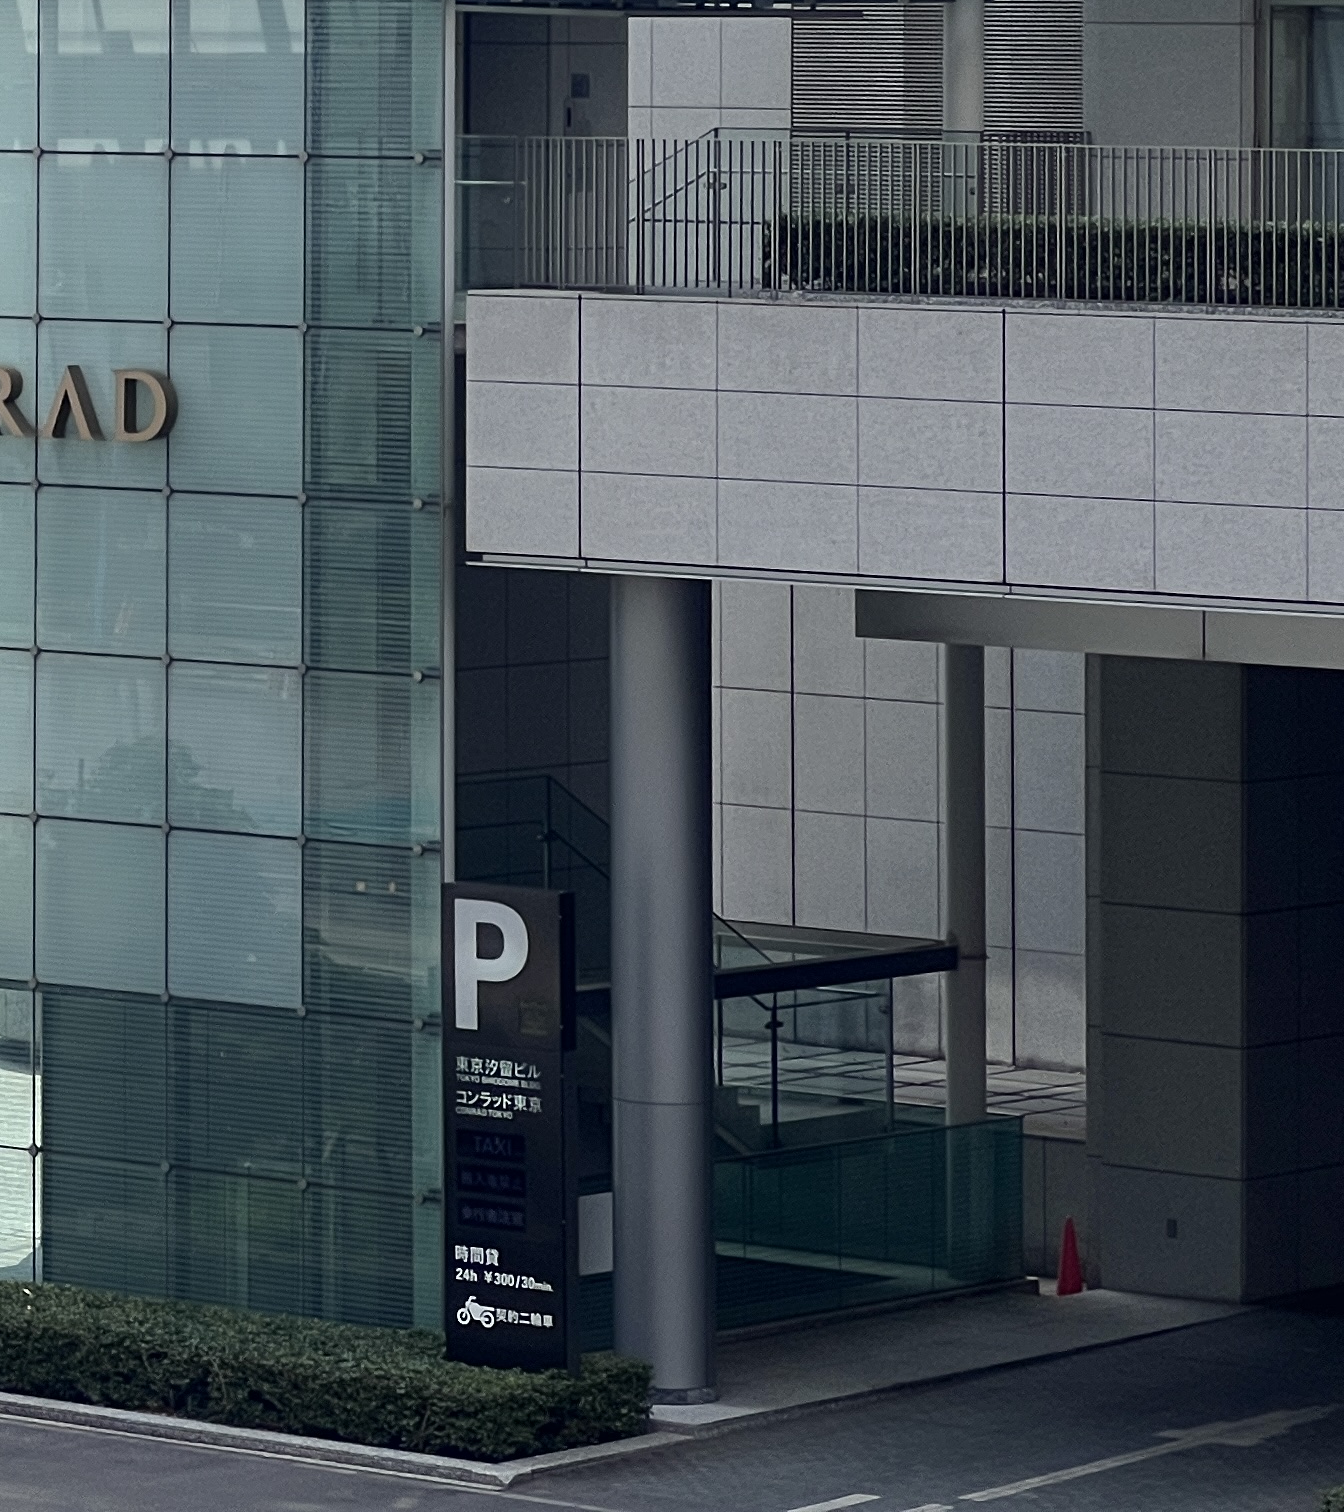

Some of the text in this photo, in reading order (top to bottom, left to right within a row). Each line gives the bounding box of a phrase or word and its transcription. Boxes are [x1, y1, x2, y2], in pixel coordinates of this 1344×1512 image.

[454, 898, 529, 1030] P
[456, 1056, 541, 1079] 東京汐留ビル
[456, 1090, 542, 1113] コンラッド東京
[454, 1244, 499, 1266] 時間貸
[455, 1267, 478, 1282] 24h
